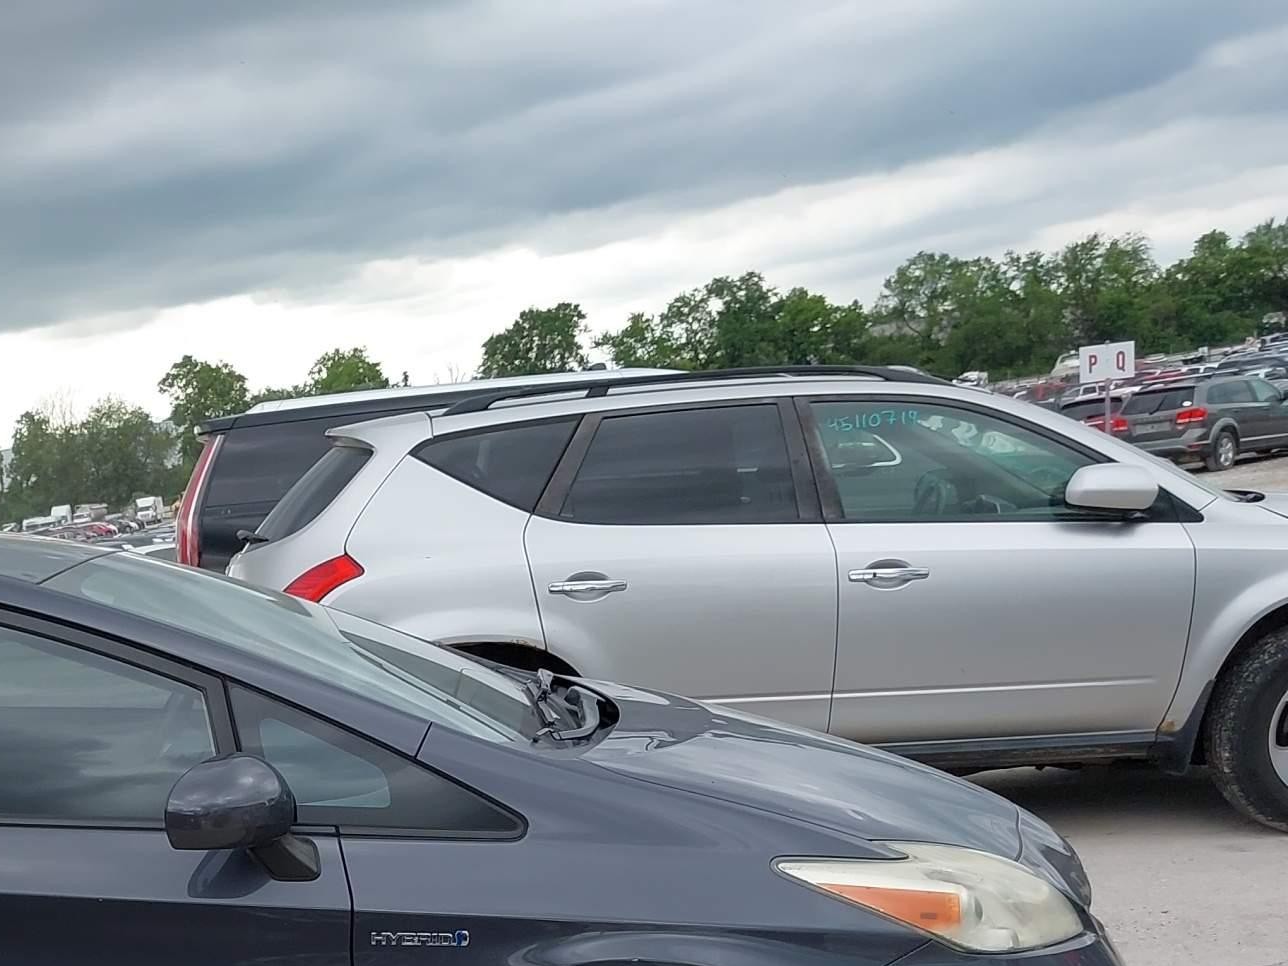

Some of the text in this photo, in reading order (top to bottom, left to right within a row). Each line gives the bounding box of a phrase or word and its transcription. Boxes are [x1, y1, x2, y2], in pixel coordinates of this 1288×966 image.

[1088, 350, 1126, 374] P Q
[370, 931, 453, 946] HYBRID
